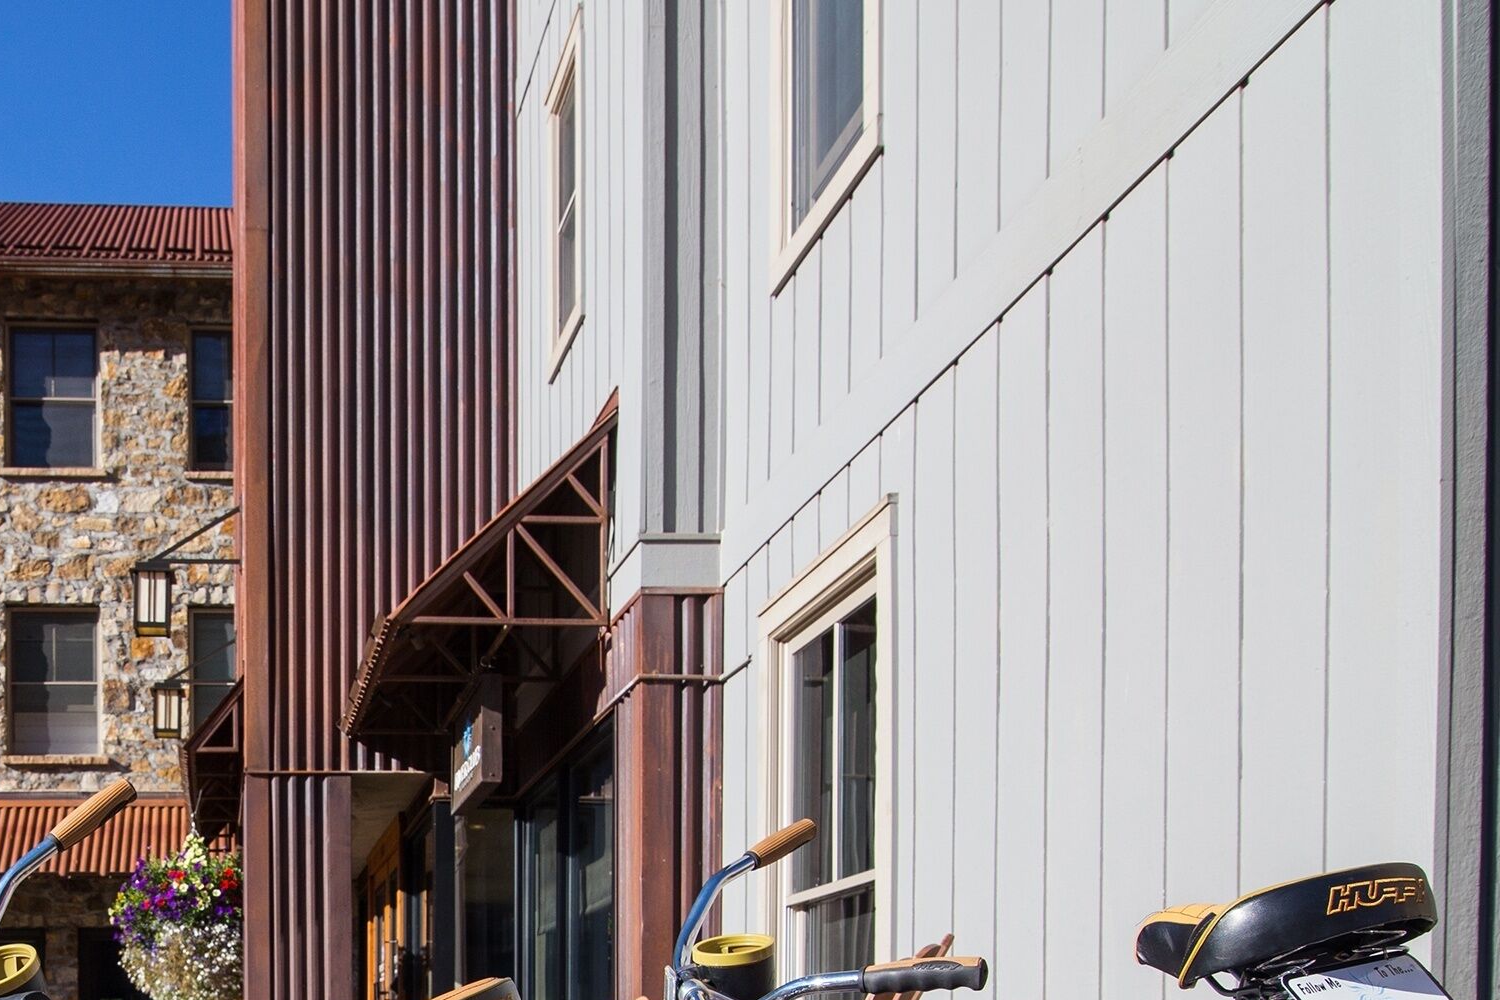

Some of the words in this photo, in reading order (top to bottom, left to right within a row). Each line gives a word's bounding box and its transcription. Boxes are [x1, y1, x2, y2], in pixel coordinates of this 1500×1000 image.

[1297, 981, 1326, 996] Follow
[1325, 977, 1342, 990] Me
[1374, 966, 1388, 979] To
